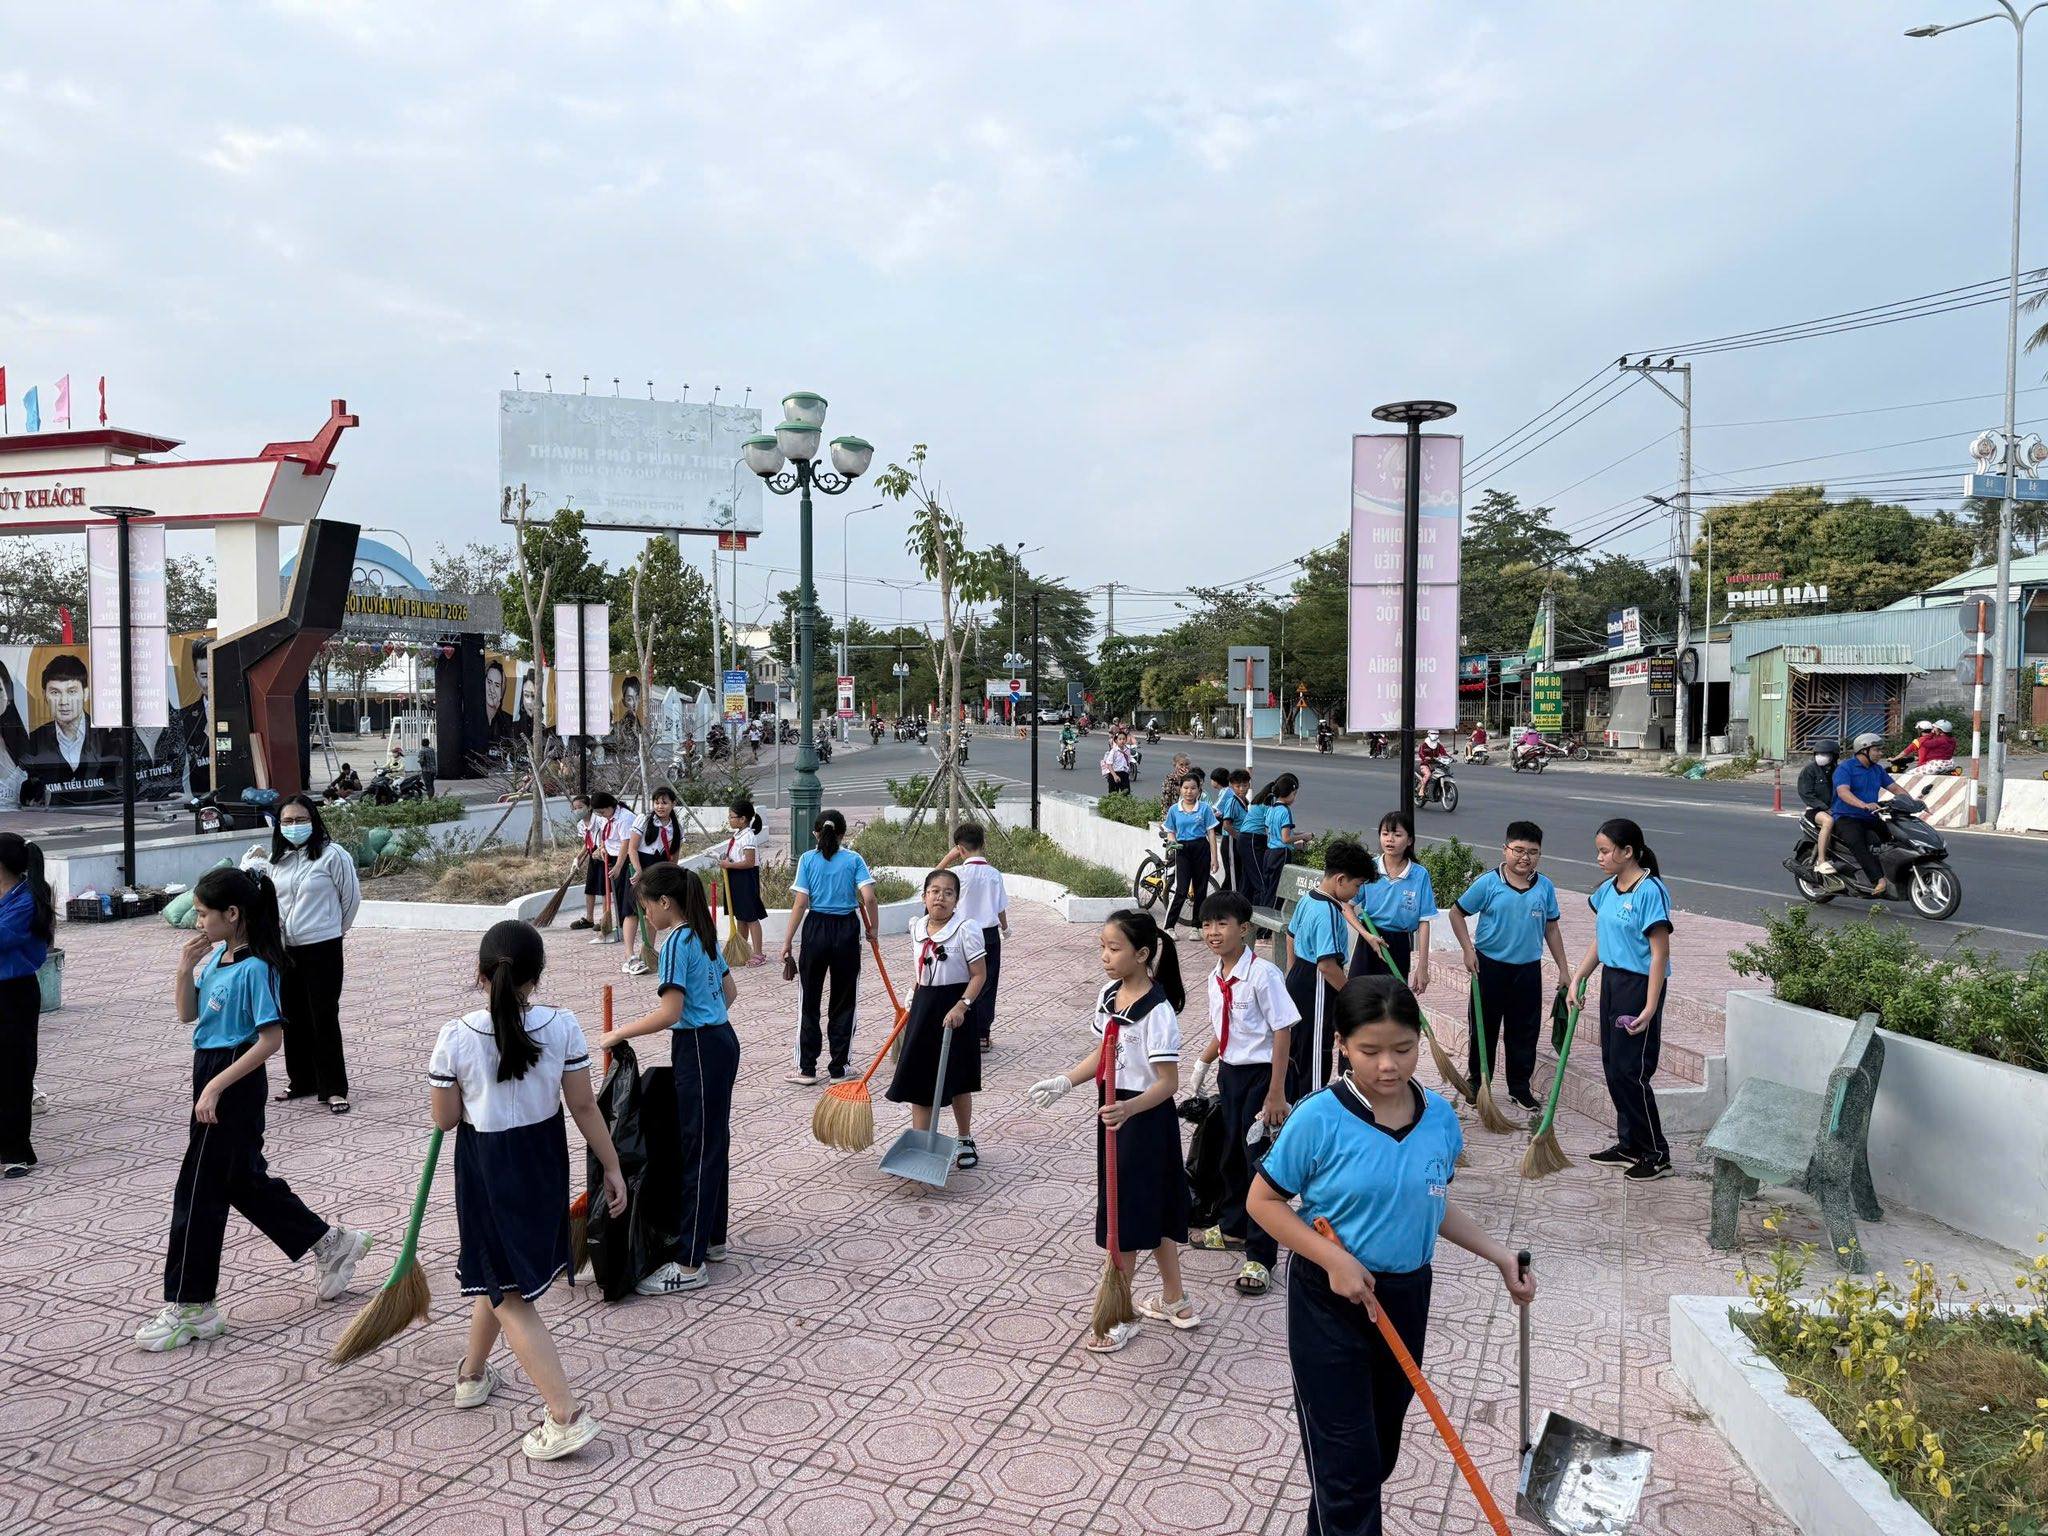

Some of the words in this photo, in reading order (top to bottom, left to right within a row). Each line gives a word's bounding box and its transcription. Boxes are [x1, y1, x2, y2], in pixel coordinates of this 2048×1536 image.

[1728, 583, 1778, 609] PHÚ
[446, 604, 468, 620] 2026
[46, 782, 62, 793] KIM
[83, 778, 105, 788] LONG
